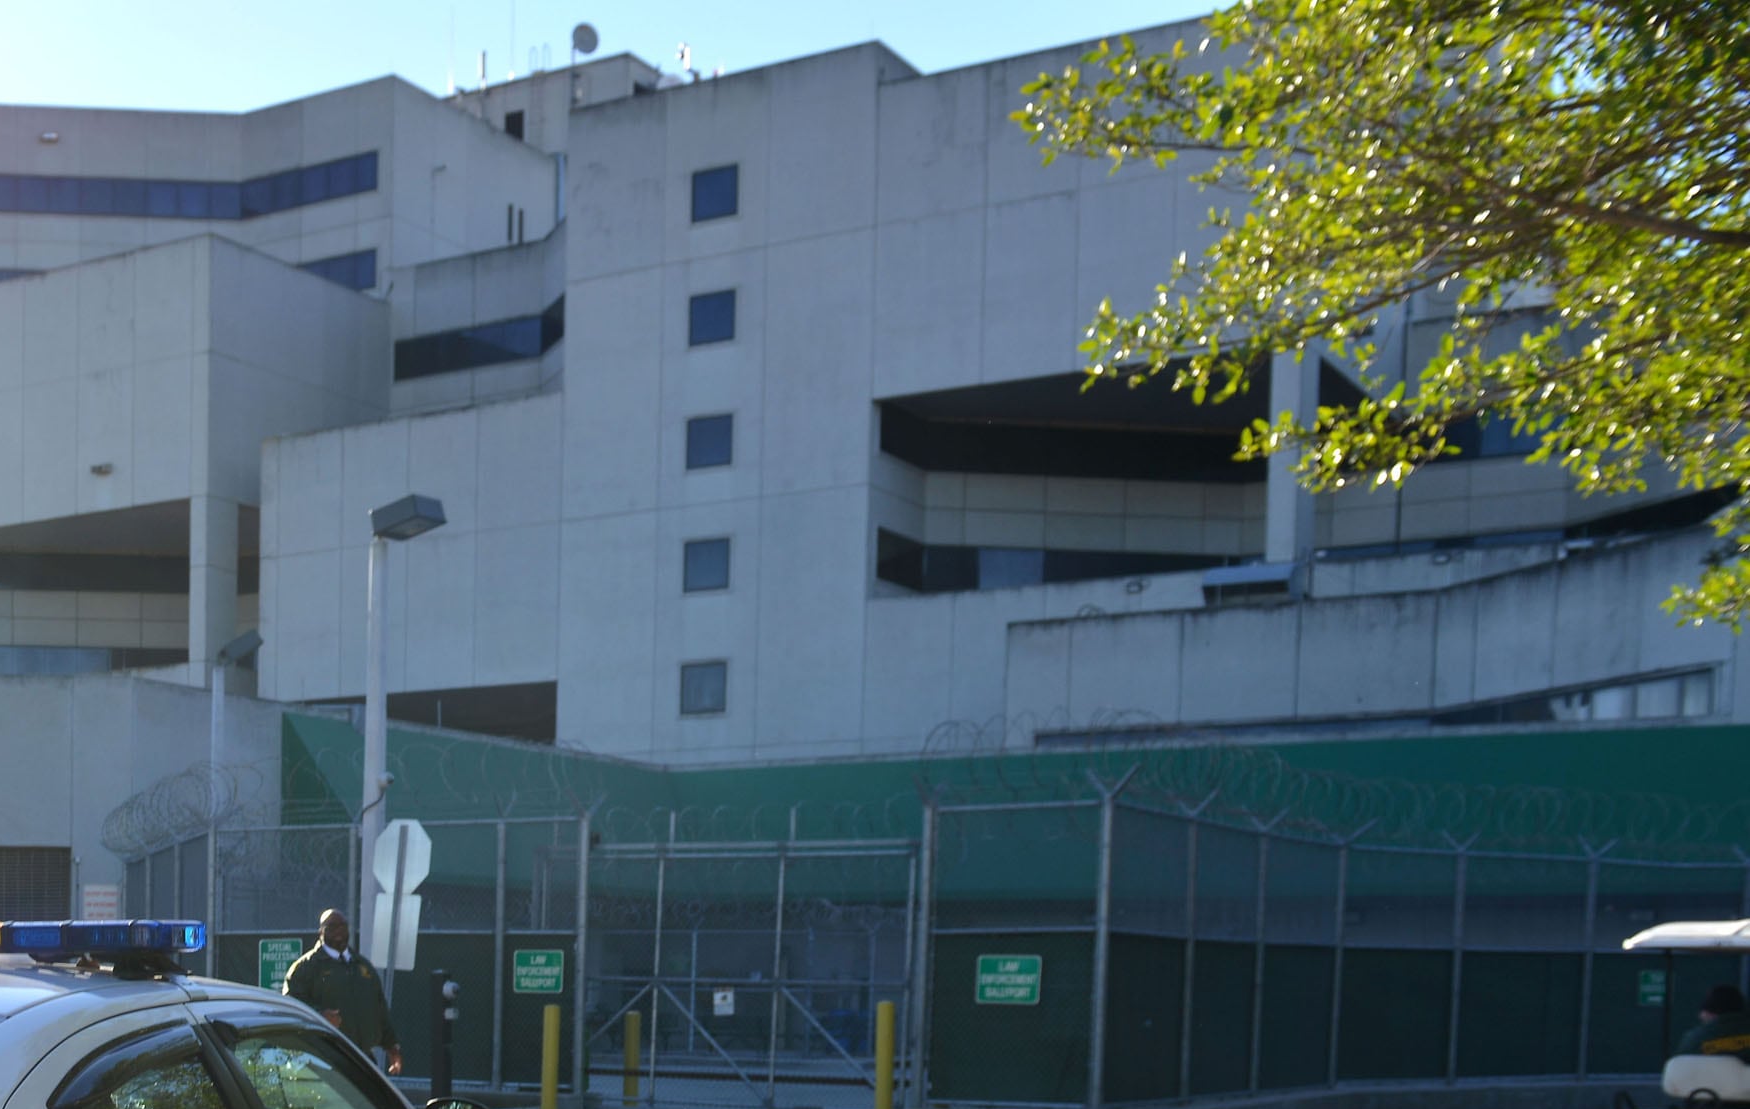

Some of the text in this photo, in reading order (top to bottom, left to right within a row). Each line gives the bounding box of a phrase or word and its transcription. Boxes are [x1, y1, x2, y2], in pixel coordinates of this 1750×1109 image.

[268, 943, 292, 952] SPECIAL
[530, 955, 546, 965] LAW
[517, 966, 560, 976] ENFORCEMENT
[998, 961, 1019, 972] LAW
[982, 973, 1037, 985] ENFORCEMENT
